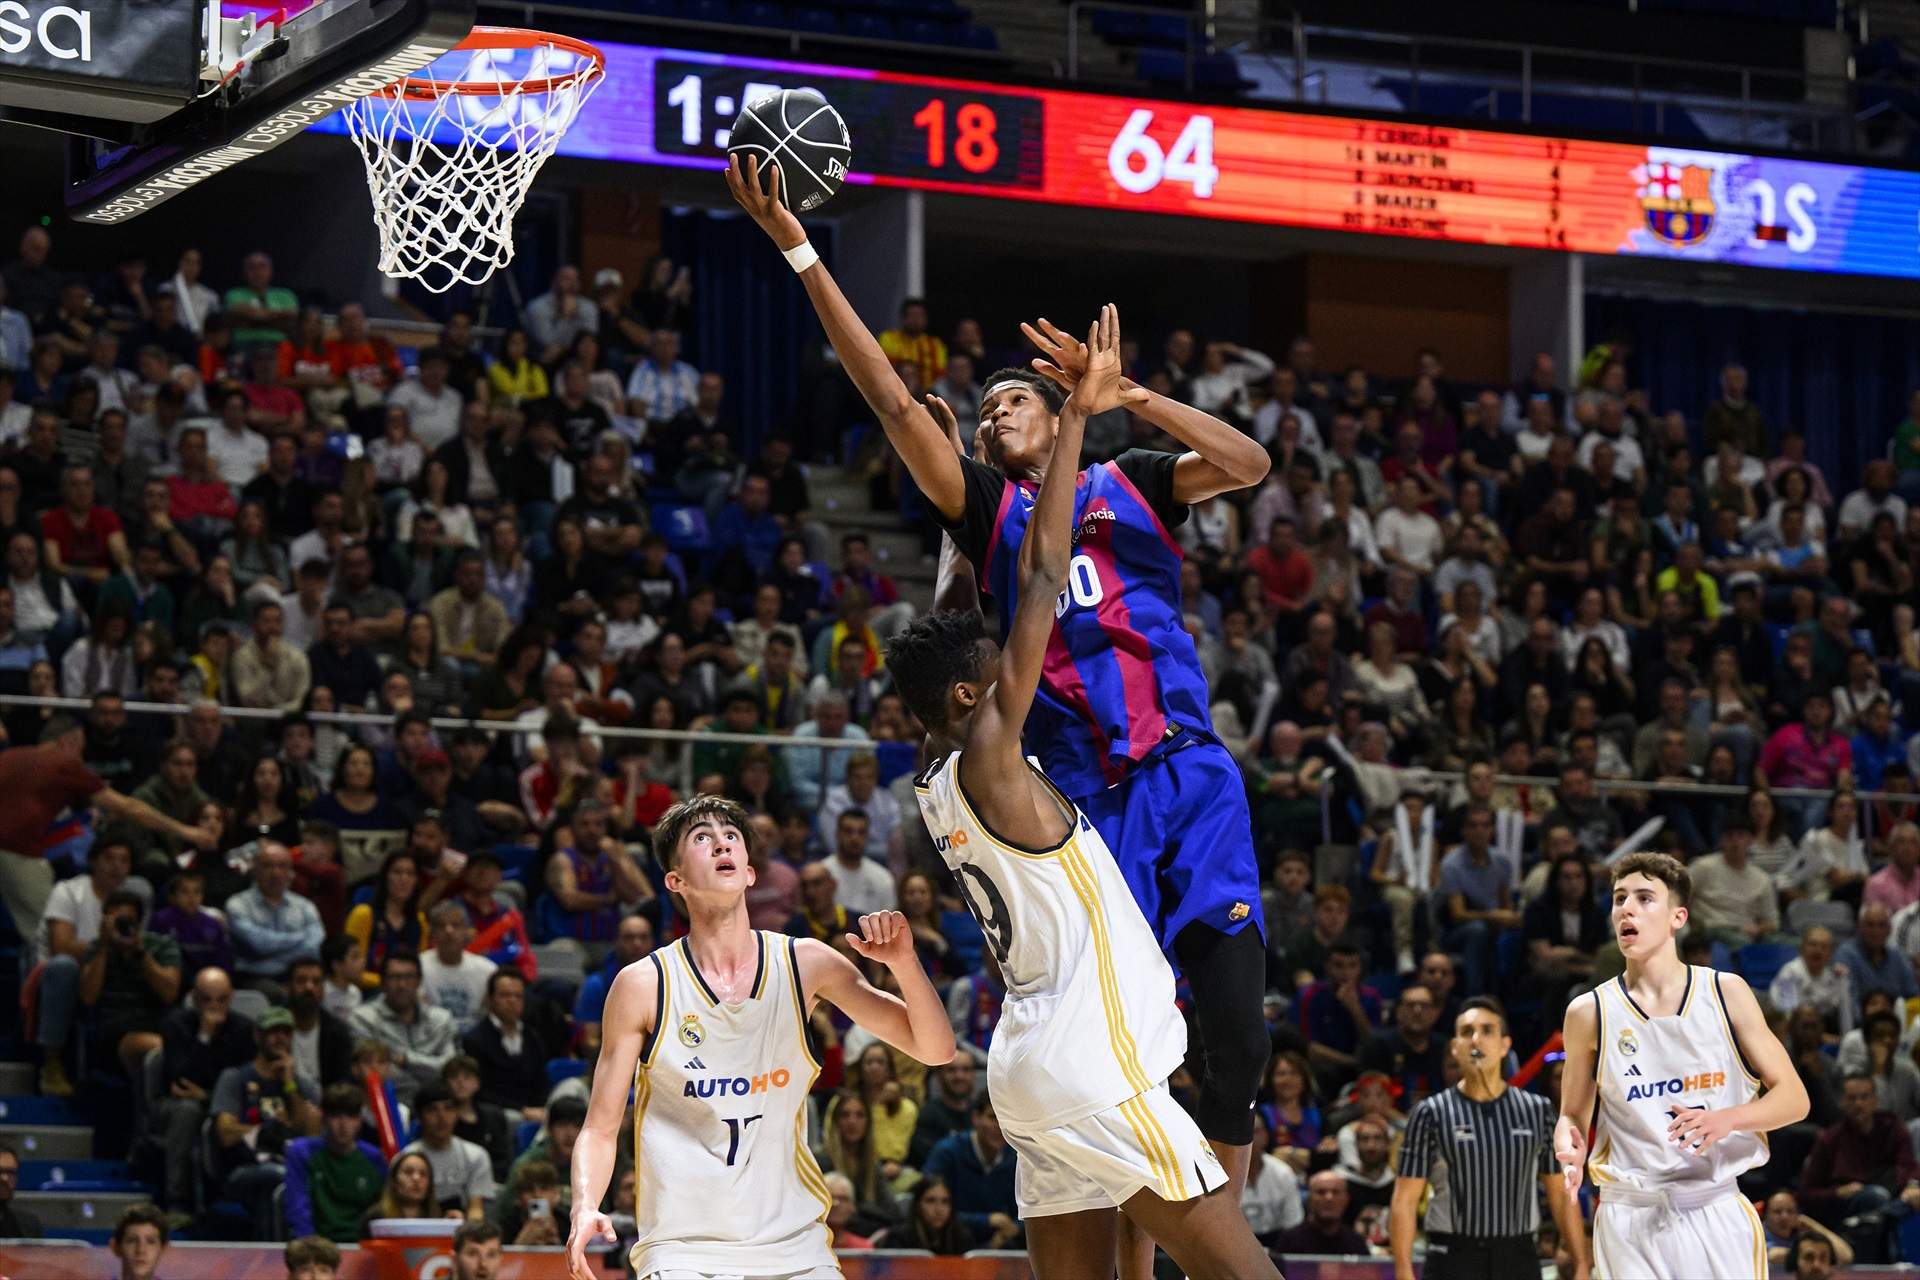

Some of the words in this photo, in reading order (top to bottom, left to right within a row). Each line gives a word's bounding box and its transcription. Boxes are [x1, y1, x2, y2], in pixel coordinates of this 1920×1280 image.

[314, 44, 449, 102] MINICOPA
[243, 100, 334, 143] endesa
[913, 99, 999, 173] 18
[146, 145, 265, 189] MINICOPA
[1108, 108, 1220, 198] 64
[86, 188, 165, 222] endesa
[684, 1069, 790, 1099] AUTOHO
